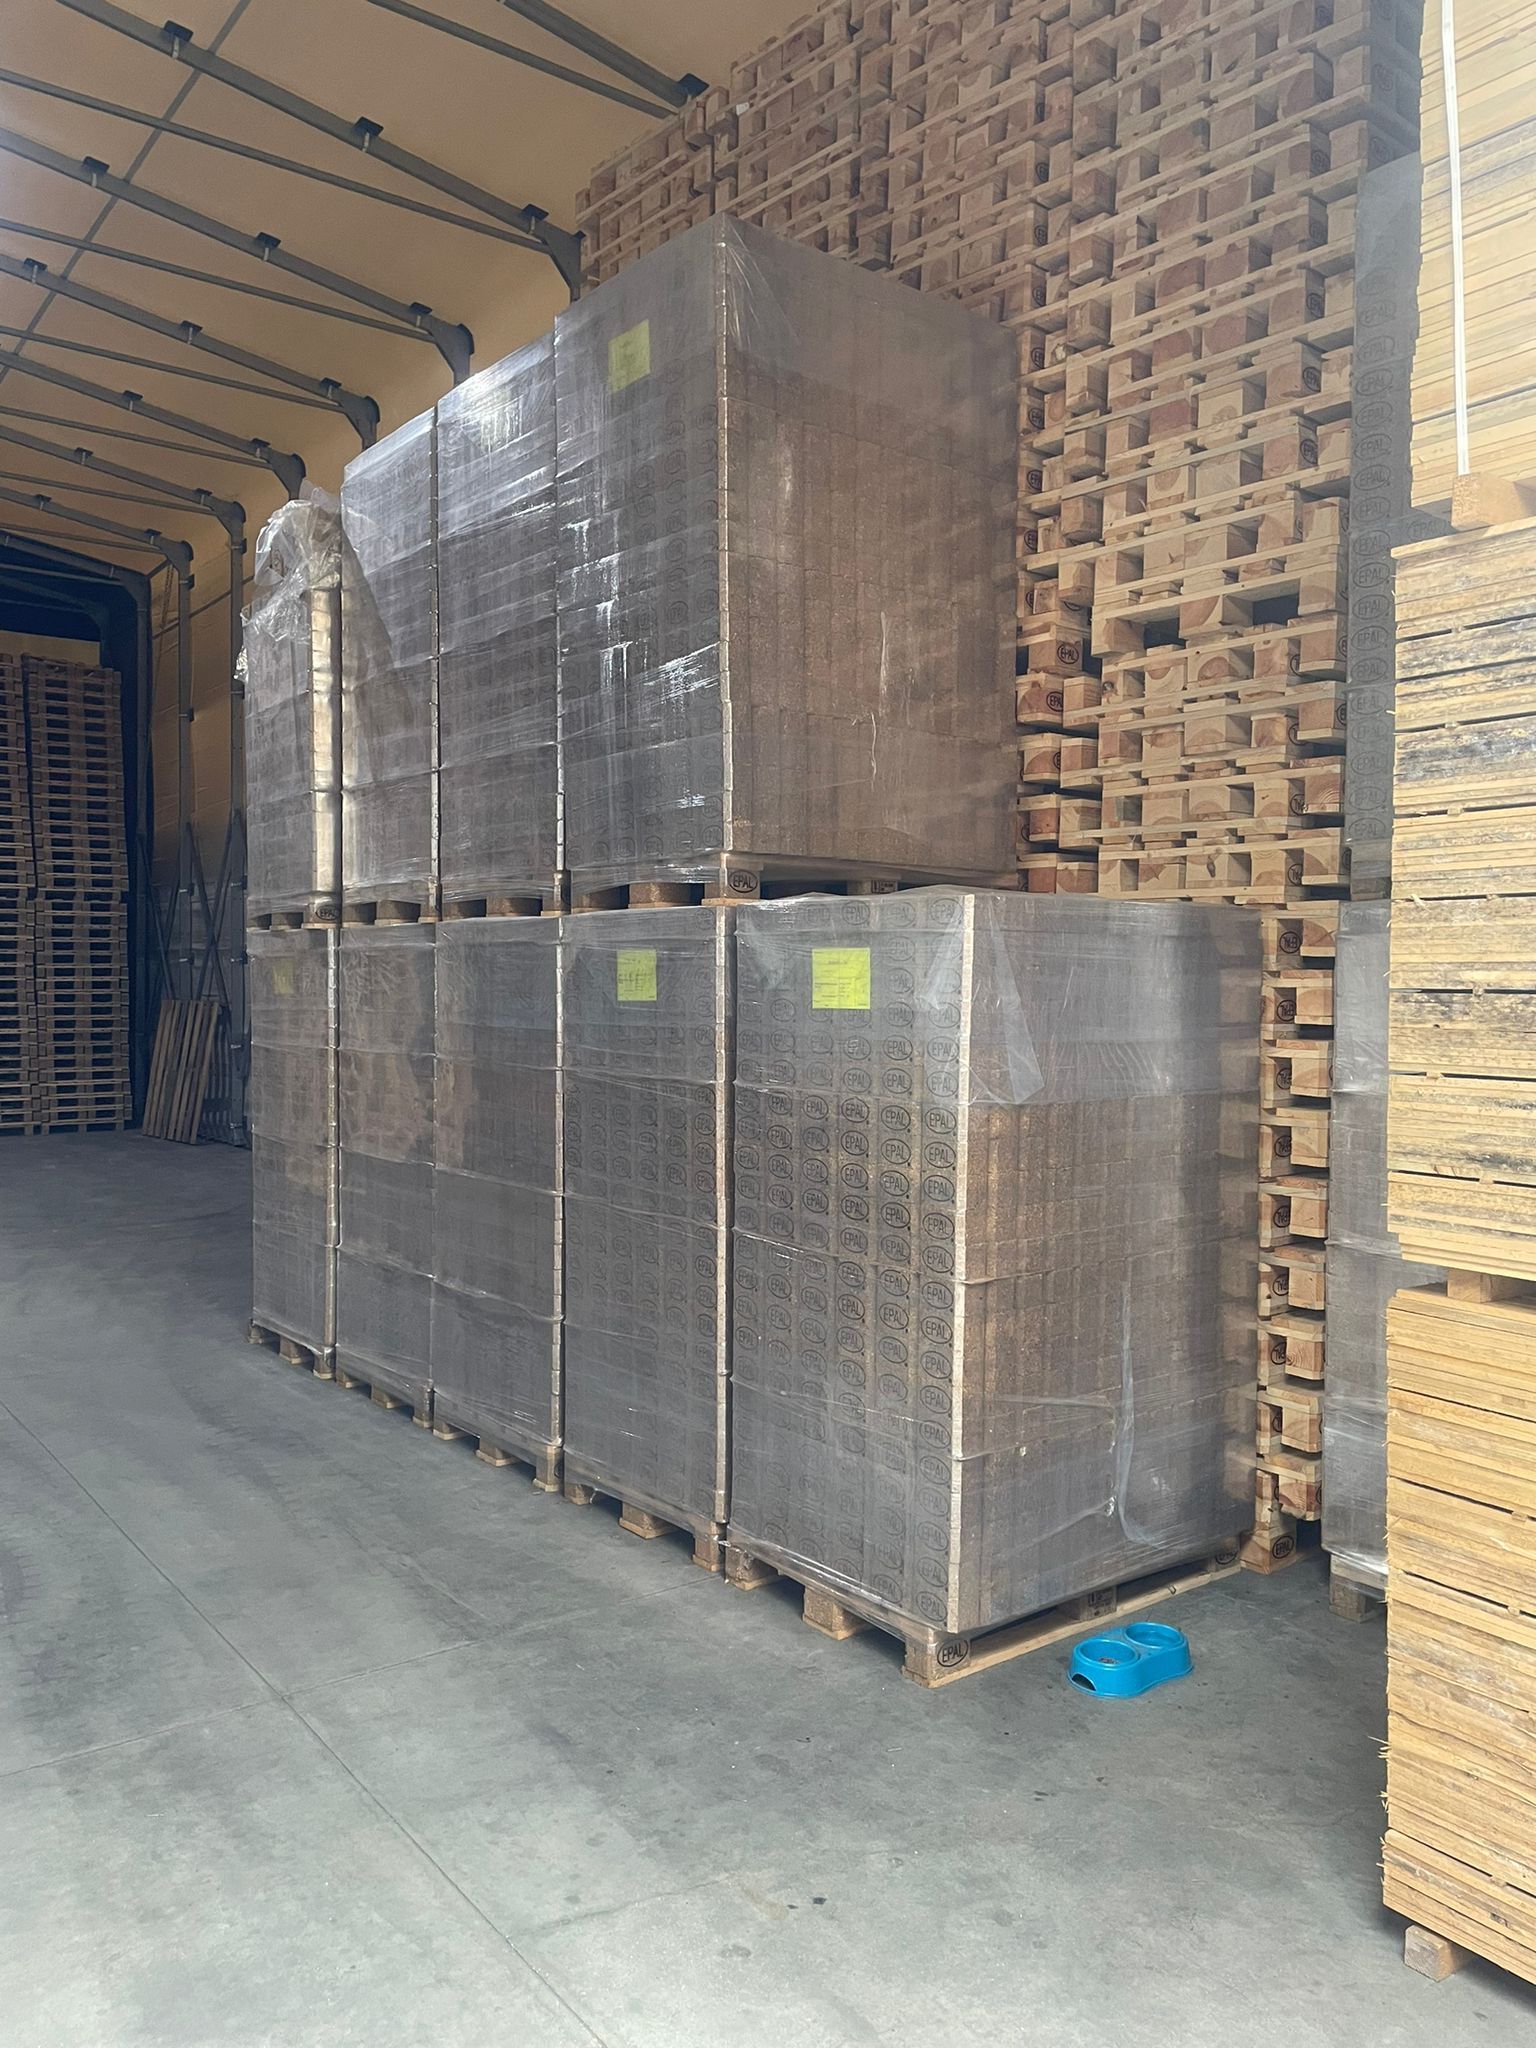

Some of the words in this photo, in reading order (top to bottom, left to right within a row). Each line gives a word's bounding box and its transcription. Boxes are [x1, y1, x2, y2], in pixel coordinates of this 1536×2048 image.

[1361, 408, 1386, 421] EPAL
[1360, 439, 1383, 454] EPAL
[1359, 470, 1386, 483] EPAL
[1358, 536, 1383, 549] EPAL
[1358, 567, 1384, 584] EPAL
[1358, 602, 1383, 616] EPAL
[1358, 633, 1382, 647] EPAL
[1061, 647, 1075, 661] EPAL
[1357, 662, 1382, 678] EPAL
[1355, 823, 1378, 837] EPAL
[733, 873, 752, 888] EPAL
[887, 1041, 909, 1055] EPAL
[848, 1074, 867, 1088] EPAL
[887, 1074, 909, 1088] EPAL
[932, 1075, 956, 1089] EPAL
[806, 1101, 823, 1115] EPAL
[845, 1103, 866, 1119] EPAL
[886, 1110, 909, 1126] EPAL
[930, 1113, 953, 1128] EPAL
[771, 1131, 787, 1145] EPAL
[845, 1137, 866, 1151] EPAL
[886, 1144, 909, 1160] EPAL
[929, 1147, 953, 1163] EPAL
[845, 1169, 865, 1184] EPAL
[883, 1176, 907, 1190] EPAL
[928, 1180, 952, 1196] EPAL
[806, 1194, 824, 1209] EPAL
[845, 1201, 865, 1216] EPAL
[885, 1208, 908, 1223] EPAL
[928, 1218, 951, 1234] EPAL
[844, 1233, 864, 1248] EPAL
[886, 1242, 908, 1257] EPAL
[927, 1252, 950, 1269] EPAL
[927, 1287, 949, 1303] EPAL
[842, 1299, 862, 1316] EPAL
[884, 1309, 907, 1327] EPAL
[926, 1321, 949, 1339] EPAL
[925, 1355, 949, 1374] EPAL
[924, 1390, 948, 1408] EPAL
[924, 1426, 947, 1443] EPAL
[924, 1461, 947, 1478] EPAL
[942, 1643, 965, 1663] EPAL
